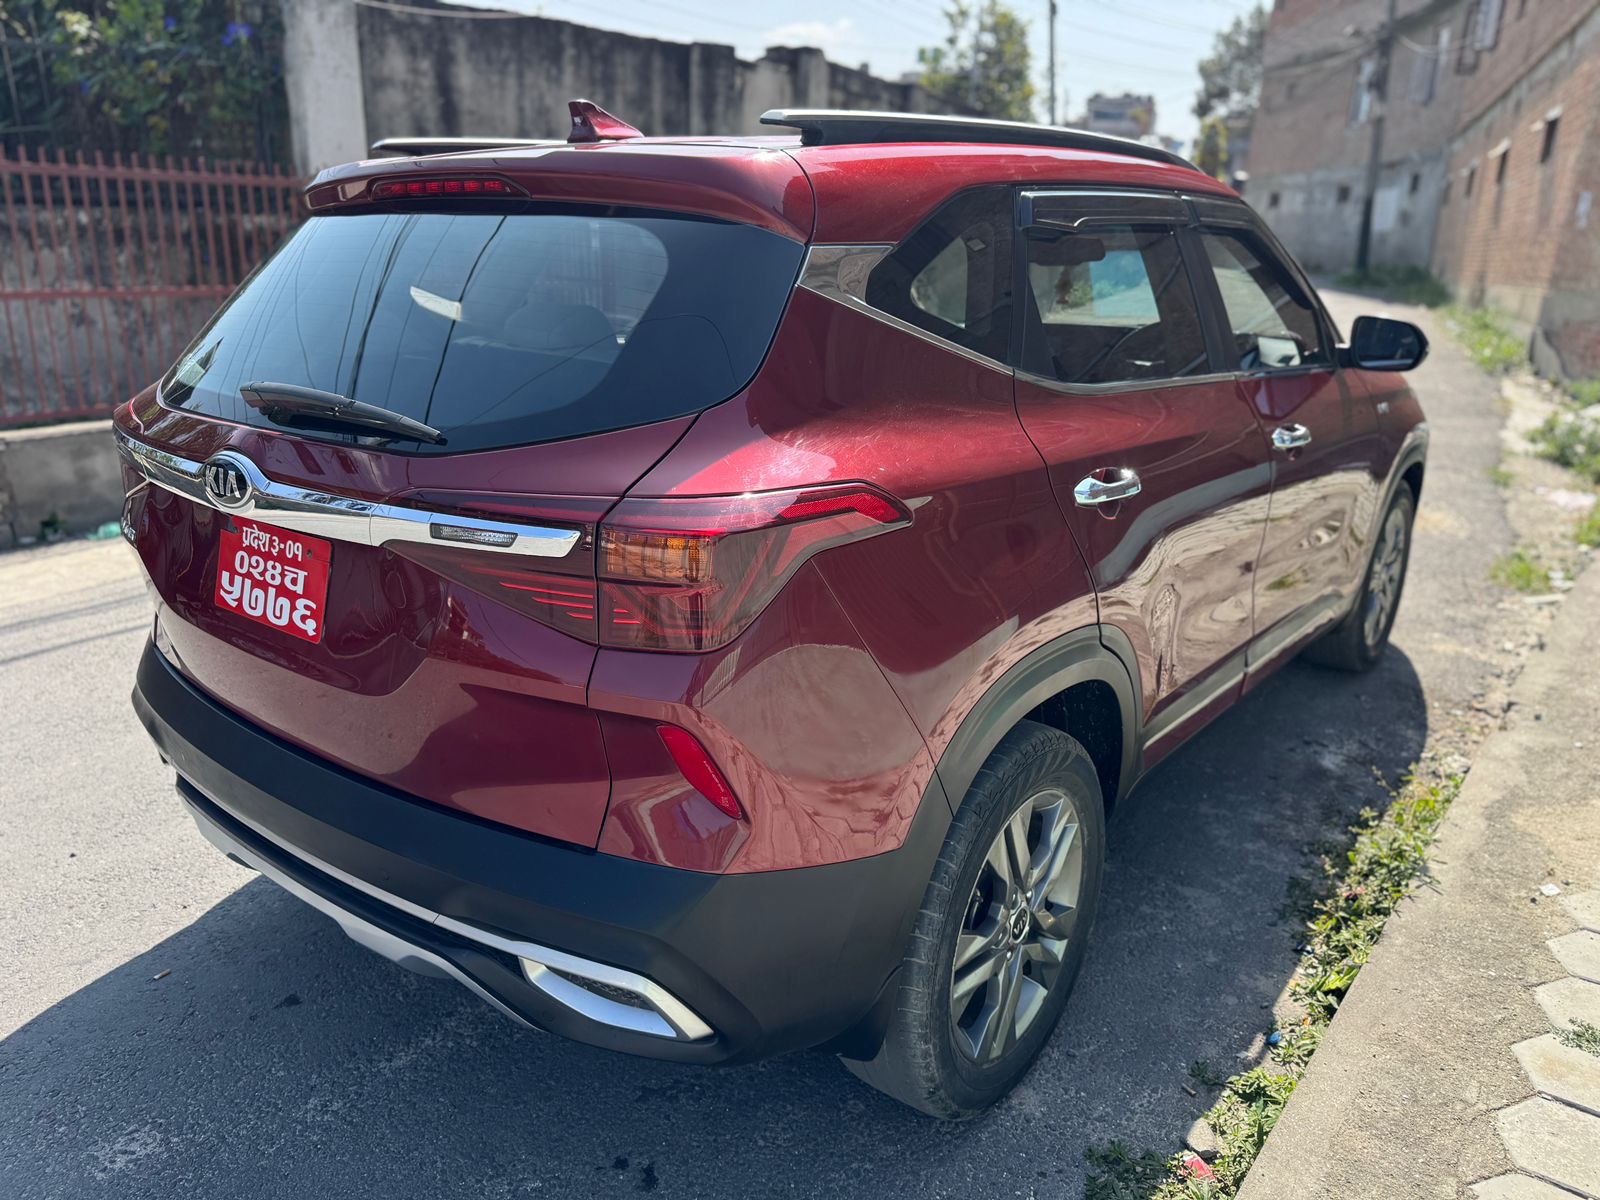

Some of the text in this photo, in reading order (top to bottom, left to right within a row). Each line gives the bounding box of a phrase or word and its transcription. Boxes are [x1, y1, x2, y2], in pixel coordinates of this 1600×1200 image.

[205, 465, 241, 499] KIA
[242, 524, 271, 553] प्रदेश
[220, 570, 317, 637] ५७७६
